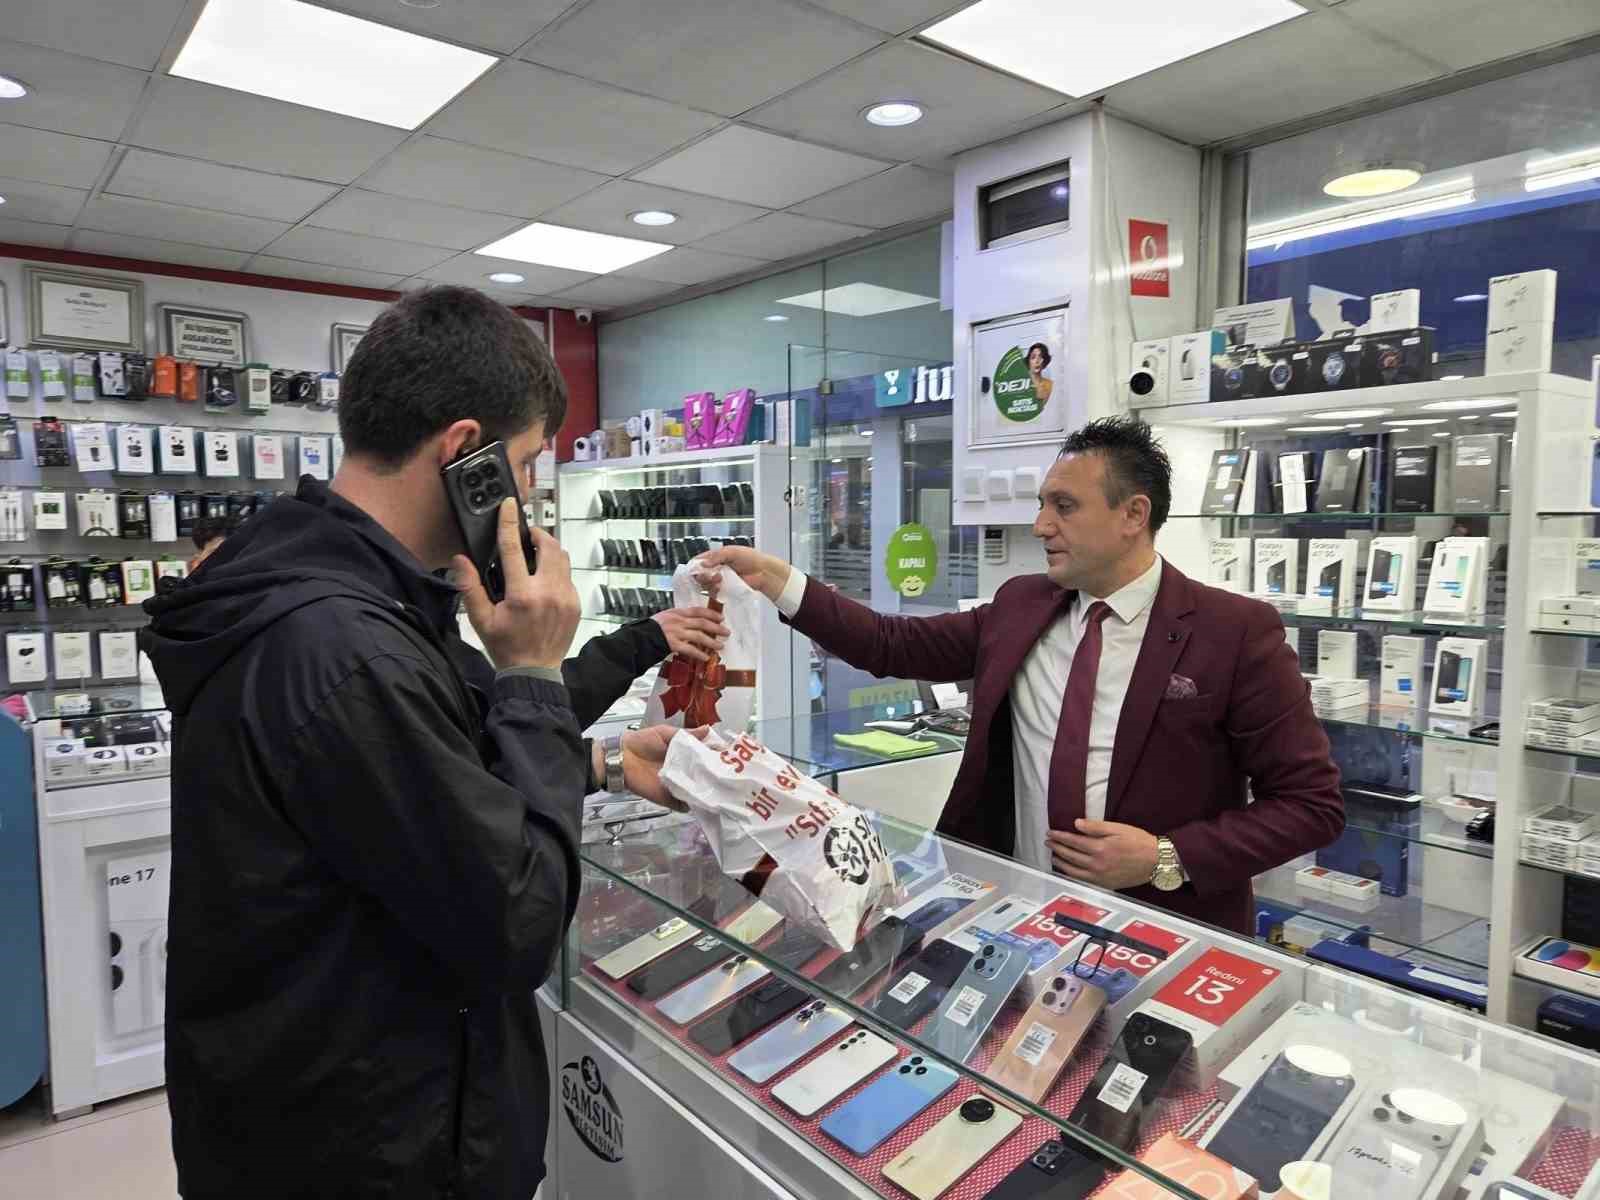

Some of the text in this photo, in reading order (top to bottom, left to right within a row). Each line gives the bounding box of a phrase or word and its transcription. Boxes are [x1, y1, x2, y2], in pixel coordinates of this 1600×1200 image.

[136, 867, 155, 882] 17
[1205, 966, 1245, 985] Redmi
[1183, 975, 1235, 1005] 13
[562, 1075, 624, 1151] SAMSUN
